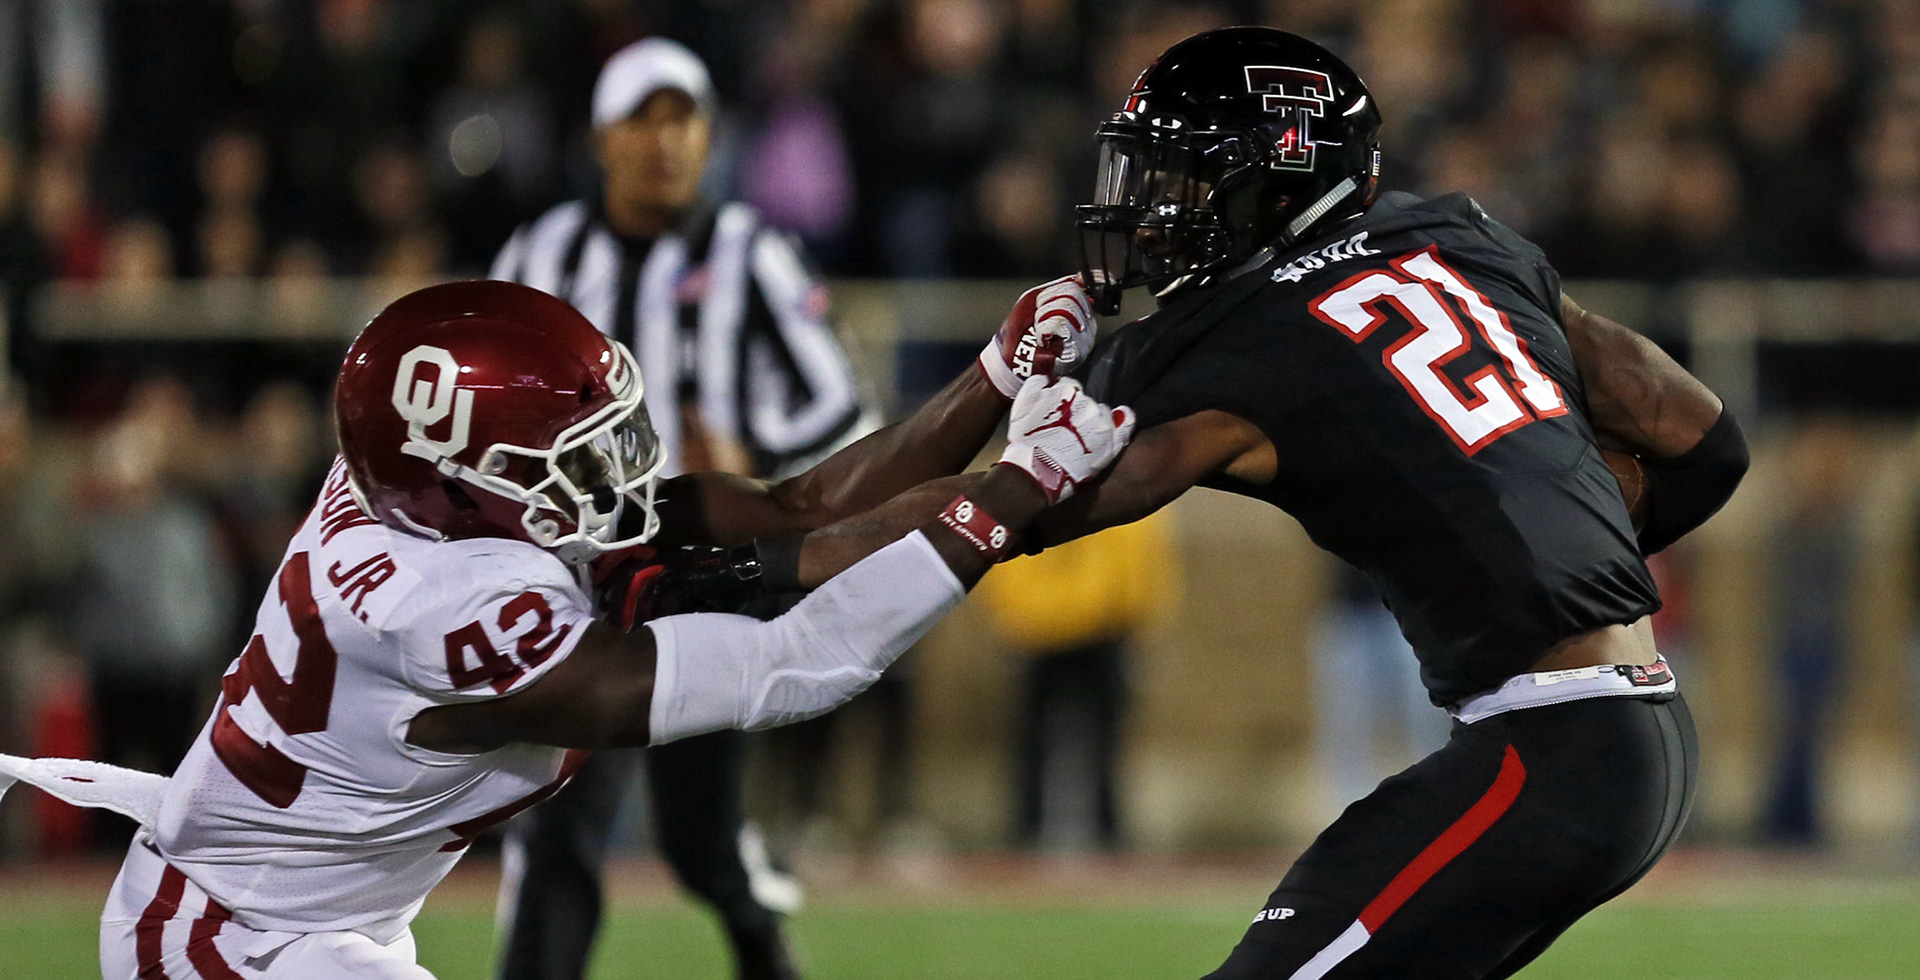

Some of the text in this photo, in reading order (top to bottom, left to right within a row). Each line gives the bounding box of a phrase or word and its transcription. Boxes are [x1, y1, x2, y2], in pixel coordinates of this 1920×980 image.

[1308, 243, 1571, 458] 21
[320, 450, 397, 624] SON JR.
[444, 591, 571, 696] 42
[1267, 907, 1295, 920] UP
